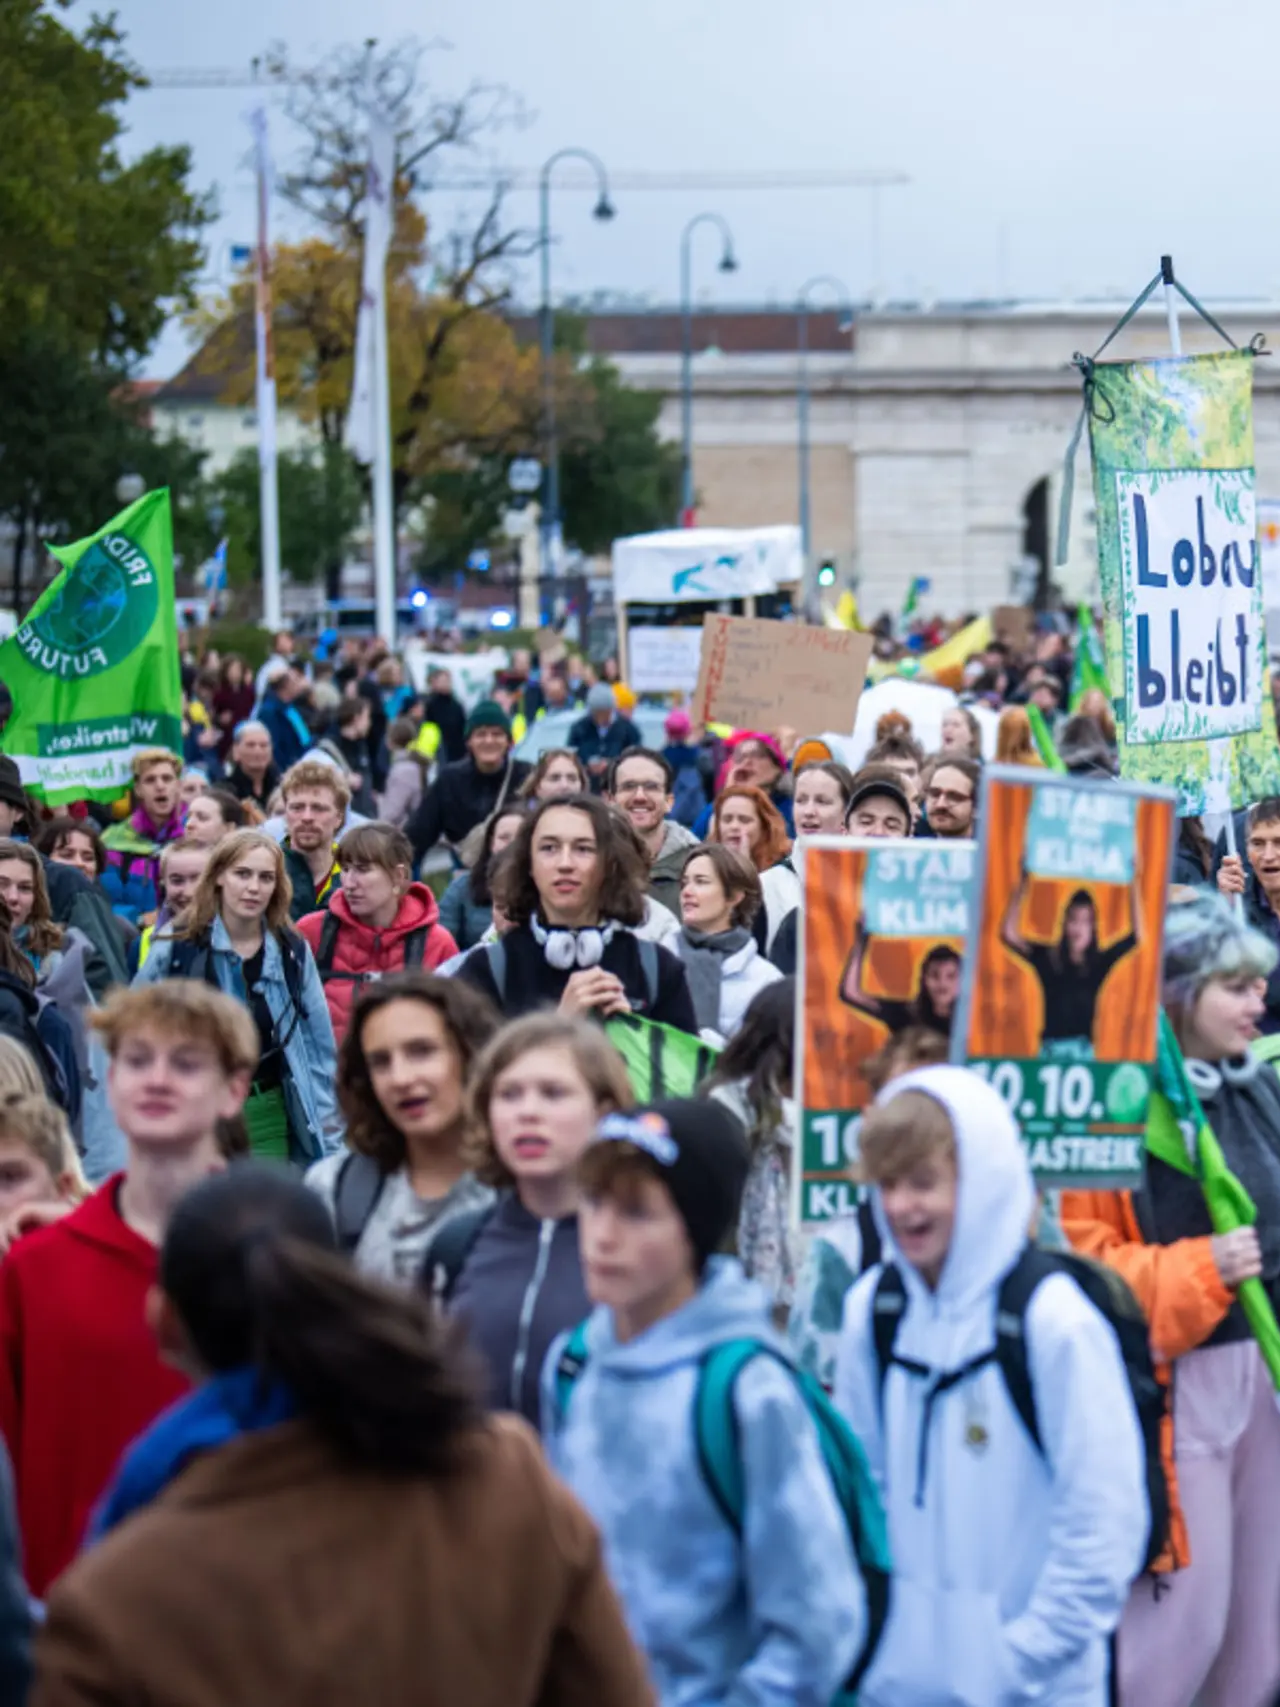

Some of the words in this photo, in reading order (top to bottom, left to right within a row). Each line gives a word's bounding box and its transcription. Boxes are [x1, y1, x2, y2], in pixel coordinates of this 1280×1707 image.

[1132, 493, 1256, 590] Lobau
[1136, 608, 1249, 708] bleibt
[876, 849, 973, 882] STAB
[878, 899, 968, 932] KLIM
[1021, 1136, 1141, 1172] ASTREIK
